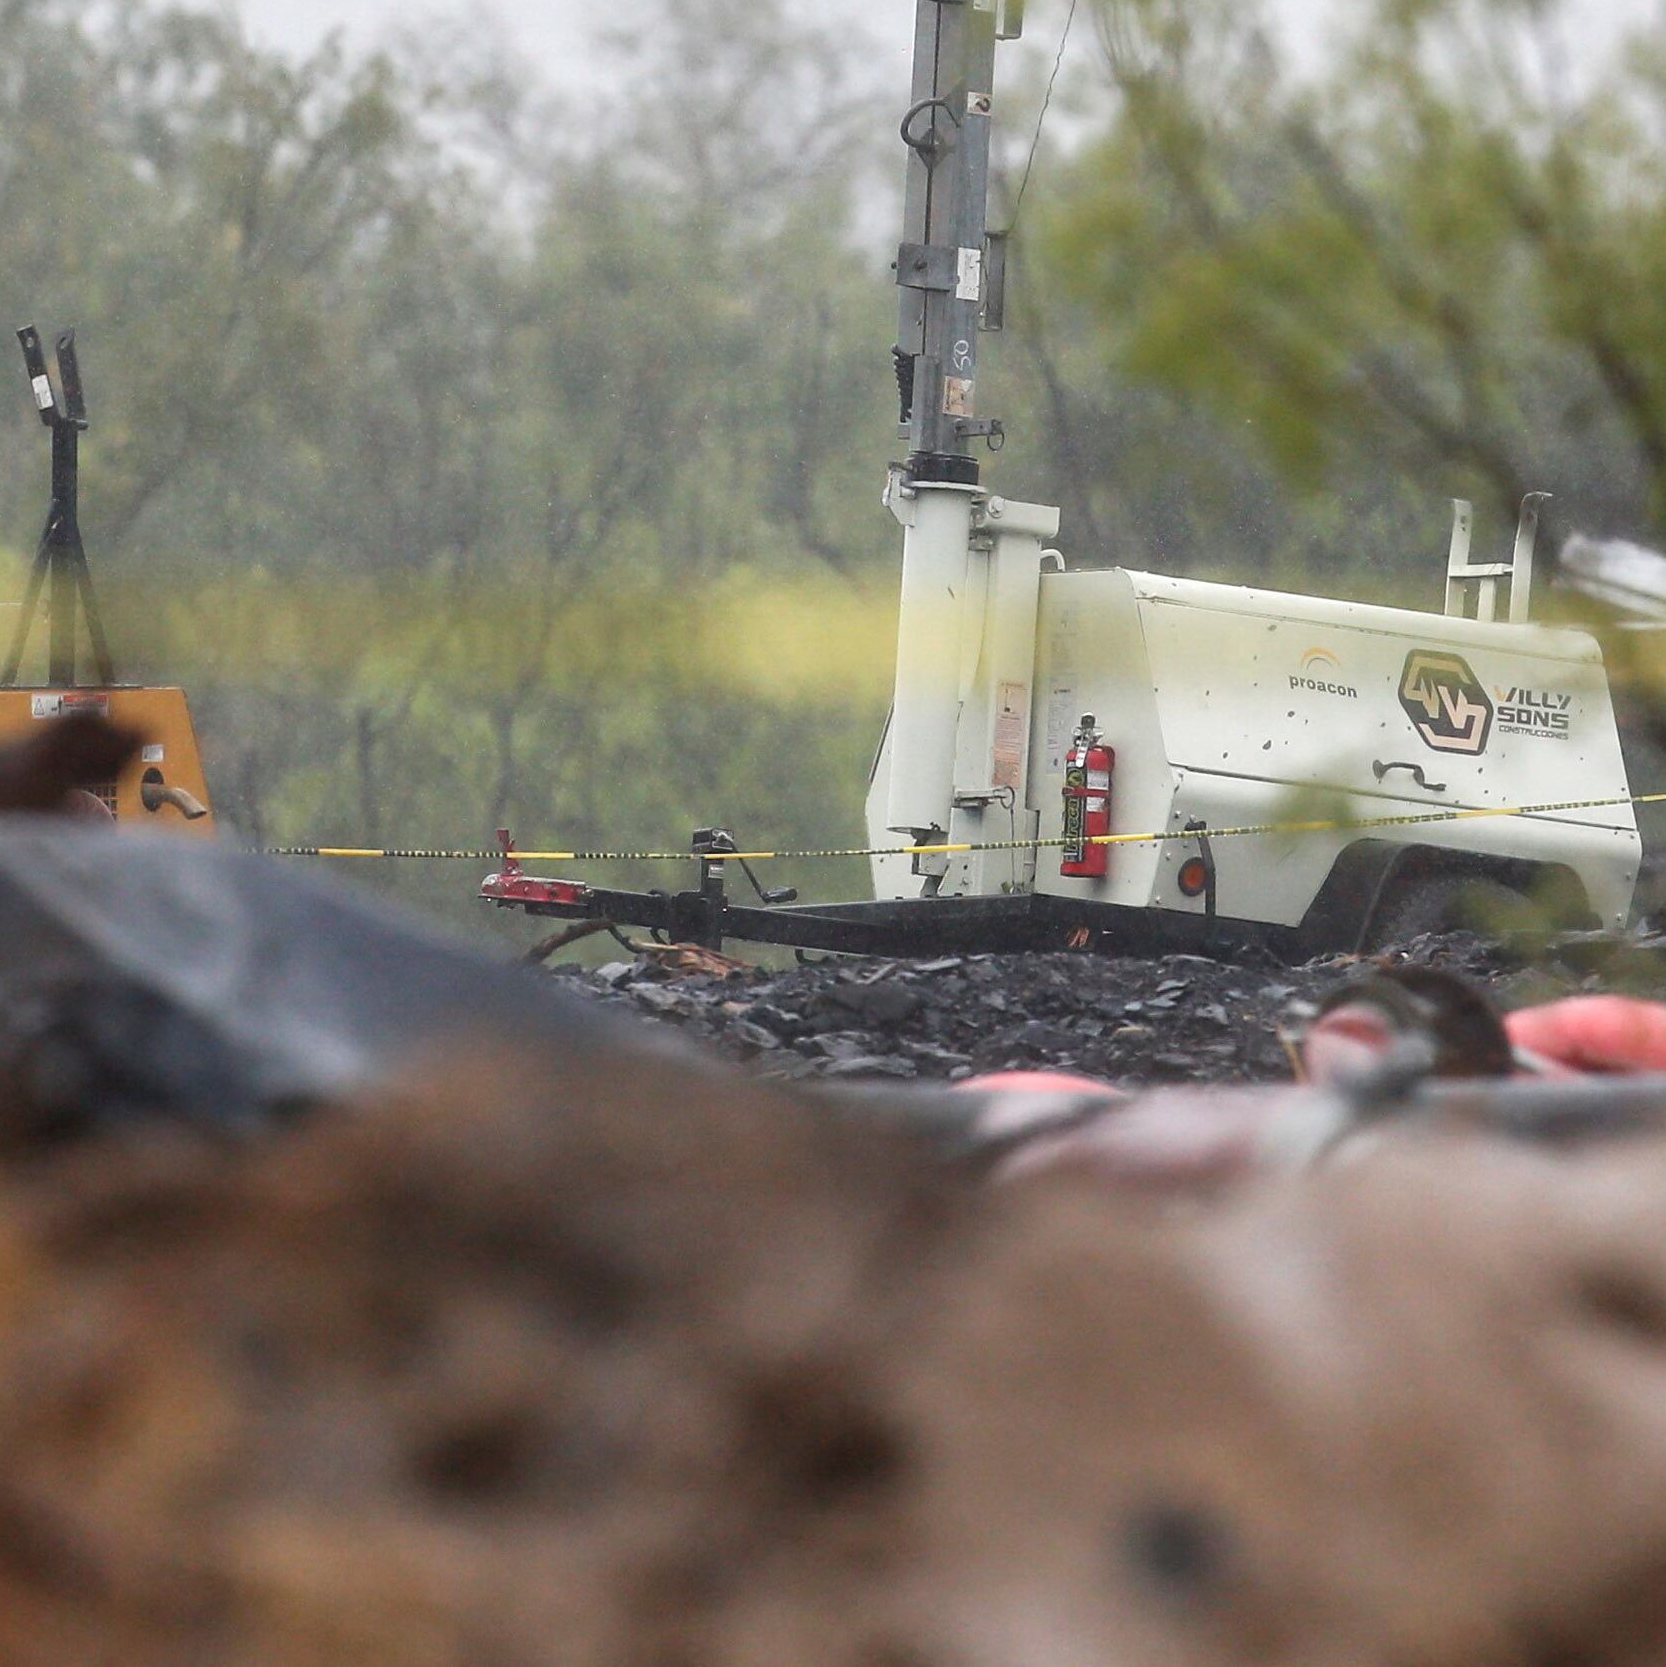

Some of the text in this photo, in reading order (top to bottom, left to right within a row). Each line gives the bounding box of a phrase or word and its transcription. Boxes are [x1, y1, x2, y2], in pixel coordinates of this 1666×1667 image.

[1289, 675, 1357, 698] proacon
[1494, 686, 1571, 710] VILLY
[1497, 706, 1569, 730] SONS
